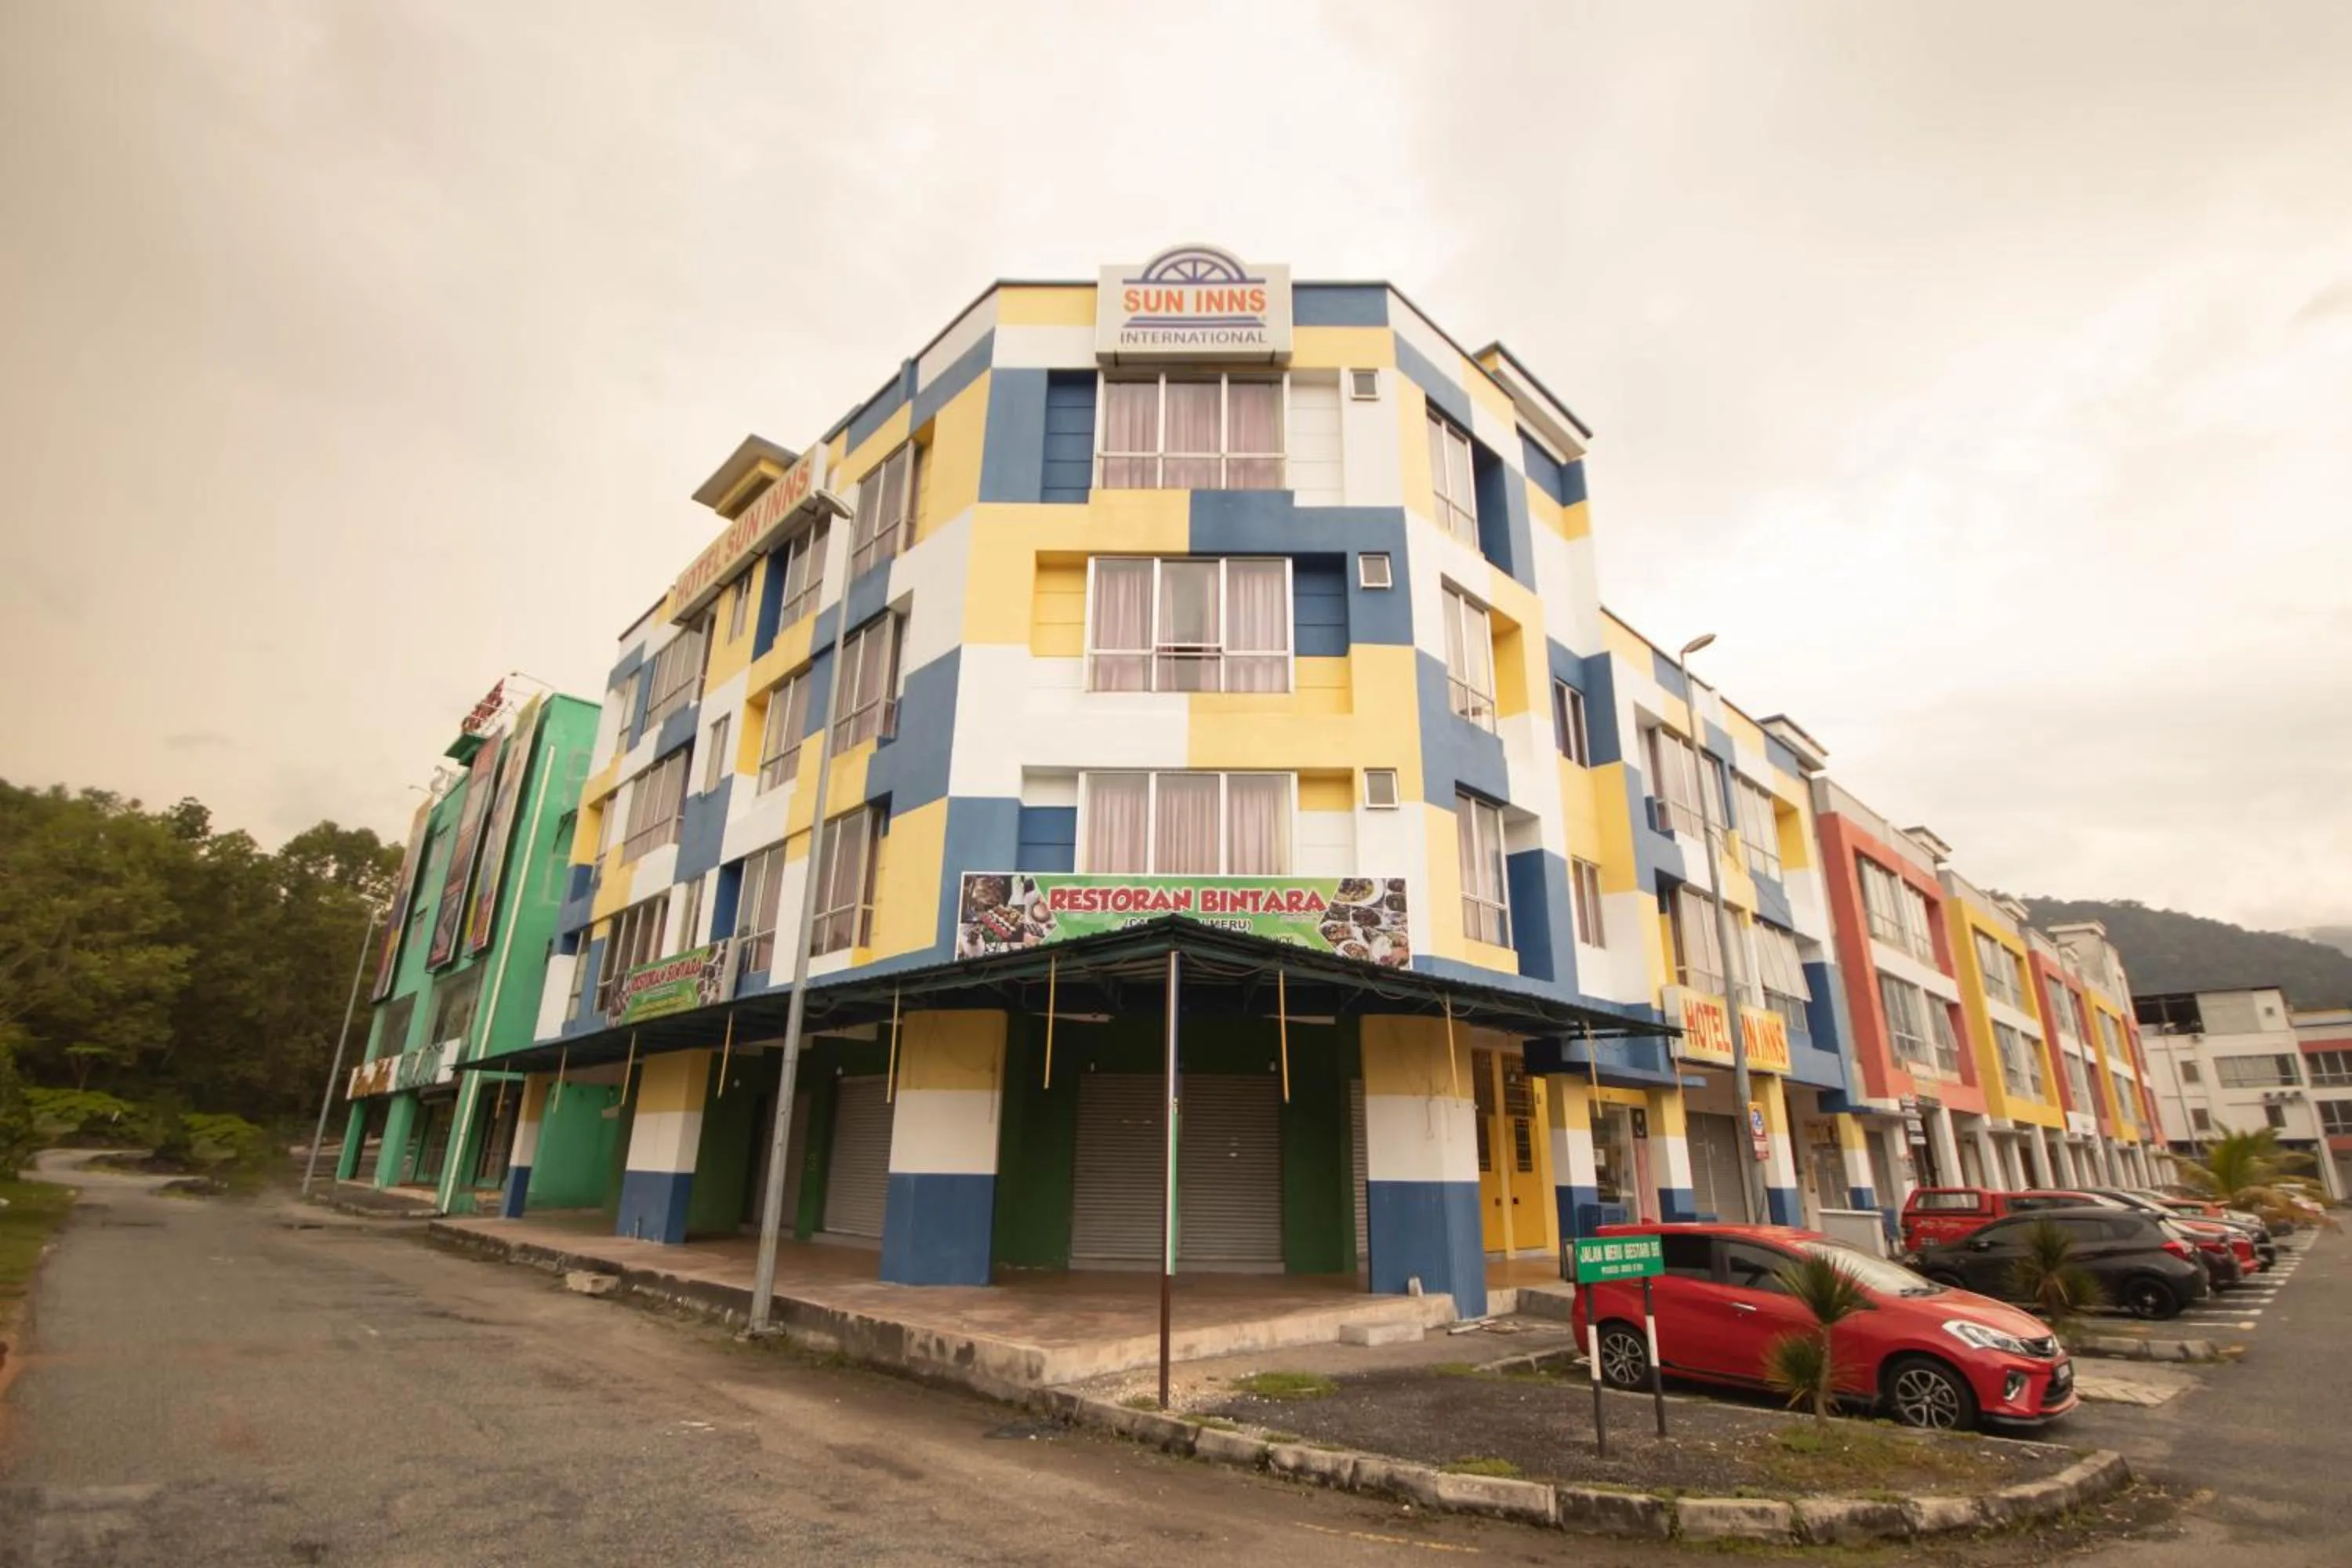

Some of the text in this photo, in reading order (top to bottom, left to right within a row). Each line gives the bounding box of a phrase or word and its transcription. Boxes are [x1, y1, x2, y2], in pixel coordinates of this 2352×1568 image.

[1123, 288, 1267, 314] SUN INNS
[1120, 331, 1268, 345] INTERNATIONAL
[724, 503, 762, 563] SUN
[764, 458, 811, 527] INNS
[1049, 887, 1327, 913] RESTORAN BINTARA
[1683, 997, 1732, 1052] HOTEL
[1580, 1245, 1602, 1263] JALAN
